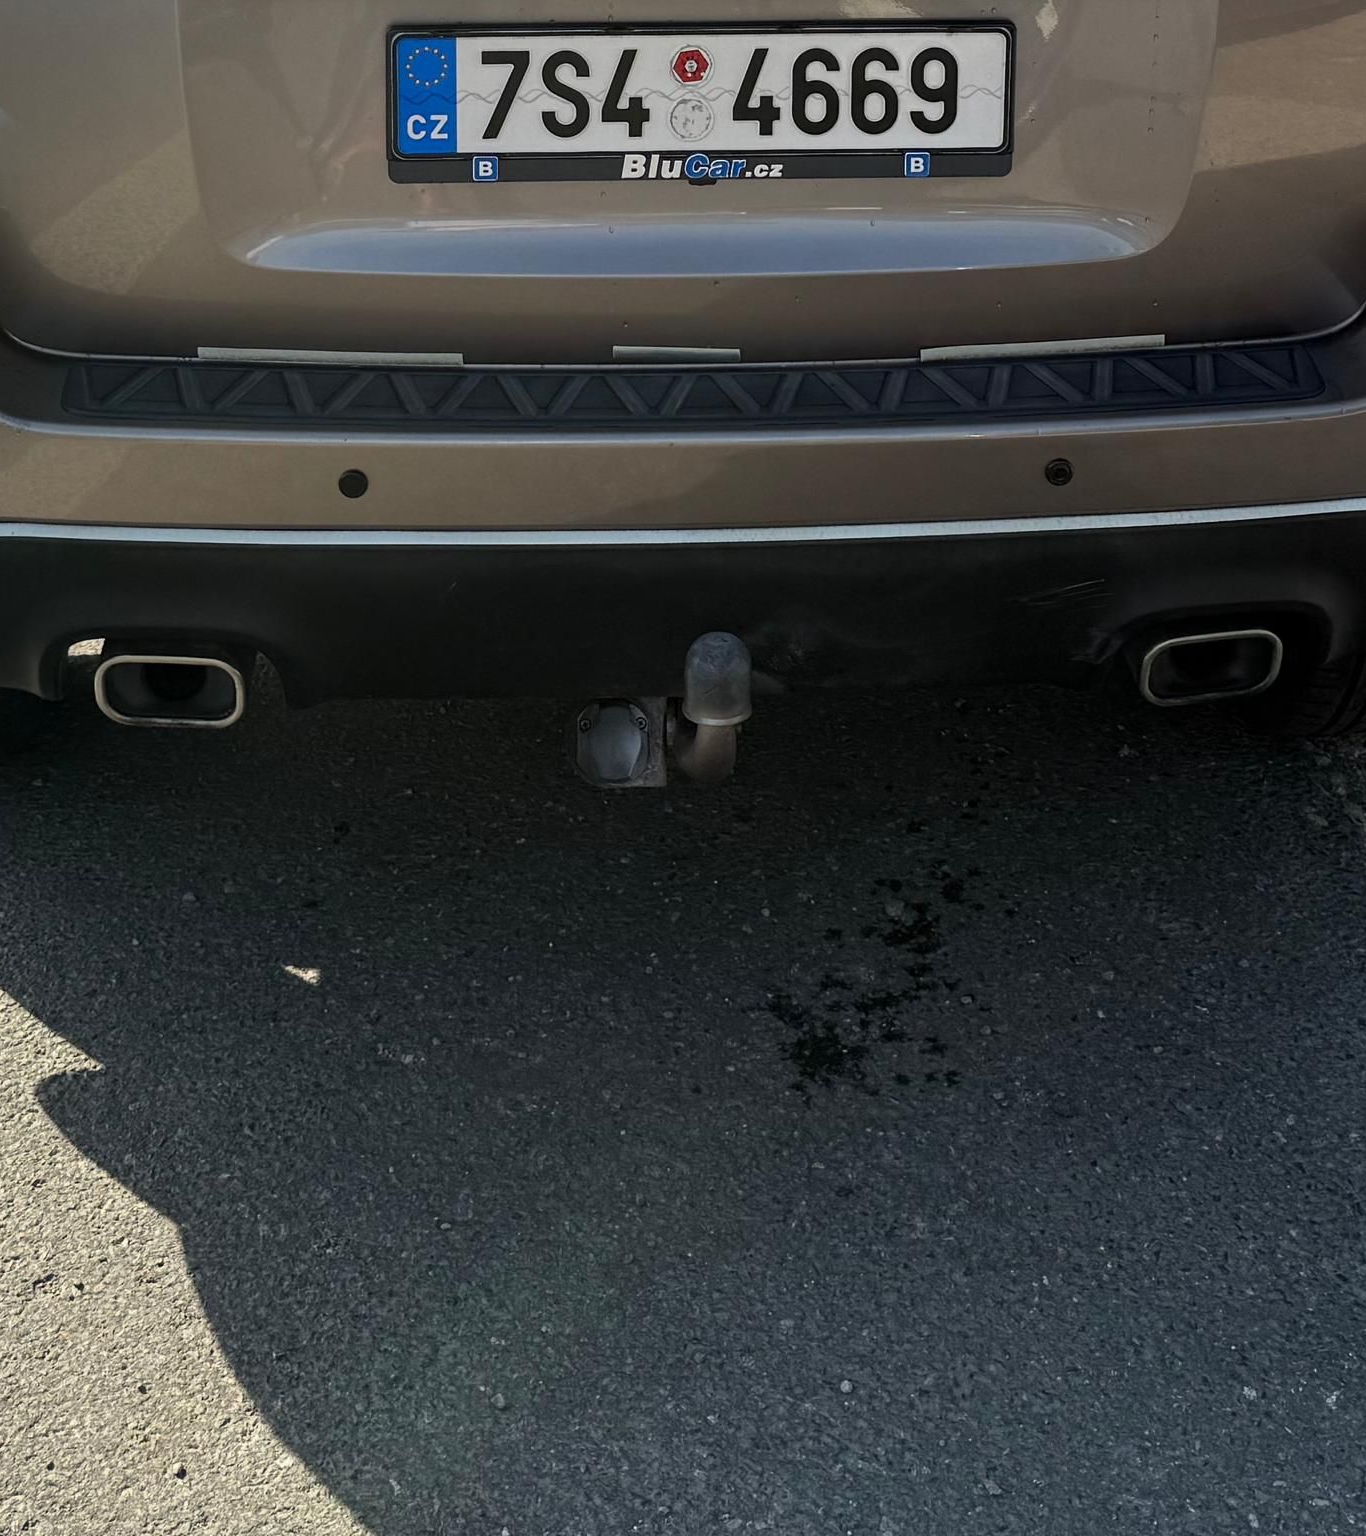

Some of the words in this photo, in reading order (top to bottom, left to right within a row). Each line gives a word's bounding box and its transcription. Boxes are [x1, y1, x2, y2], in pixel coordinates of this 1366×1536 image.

[480, 49, 650, 140] 7S4
[732, 47, 959, 136] 4669
[406, 115, 449, 141] CZ
[479, 161, 494, 176] B
[621, 153, 784, 180] BluCar.cz
[910, 157, 925, 173] B
